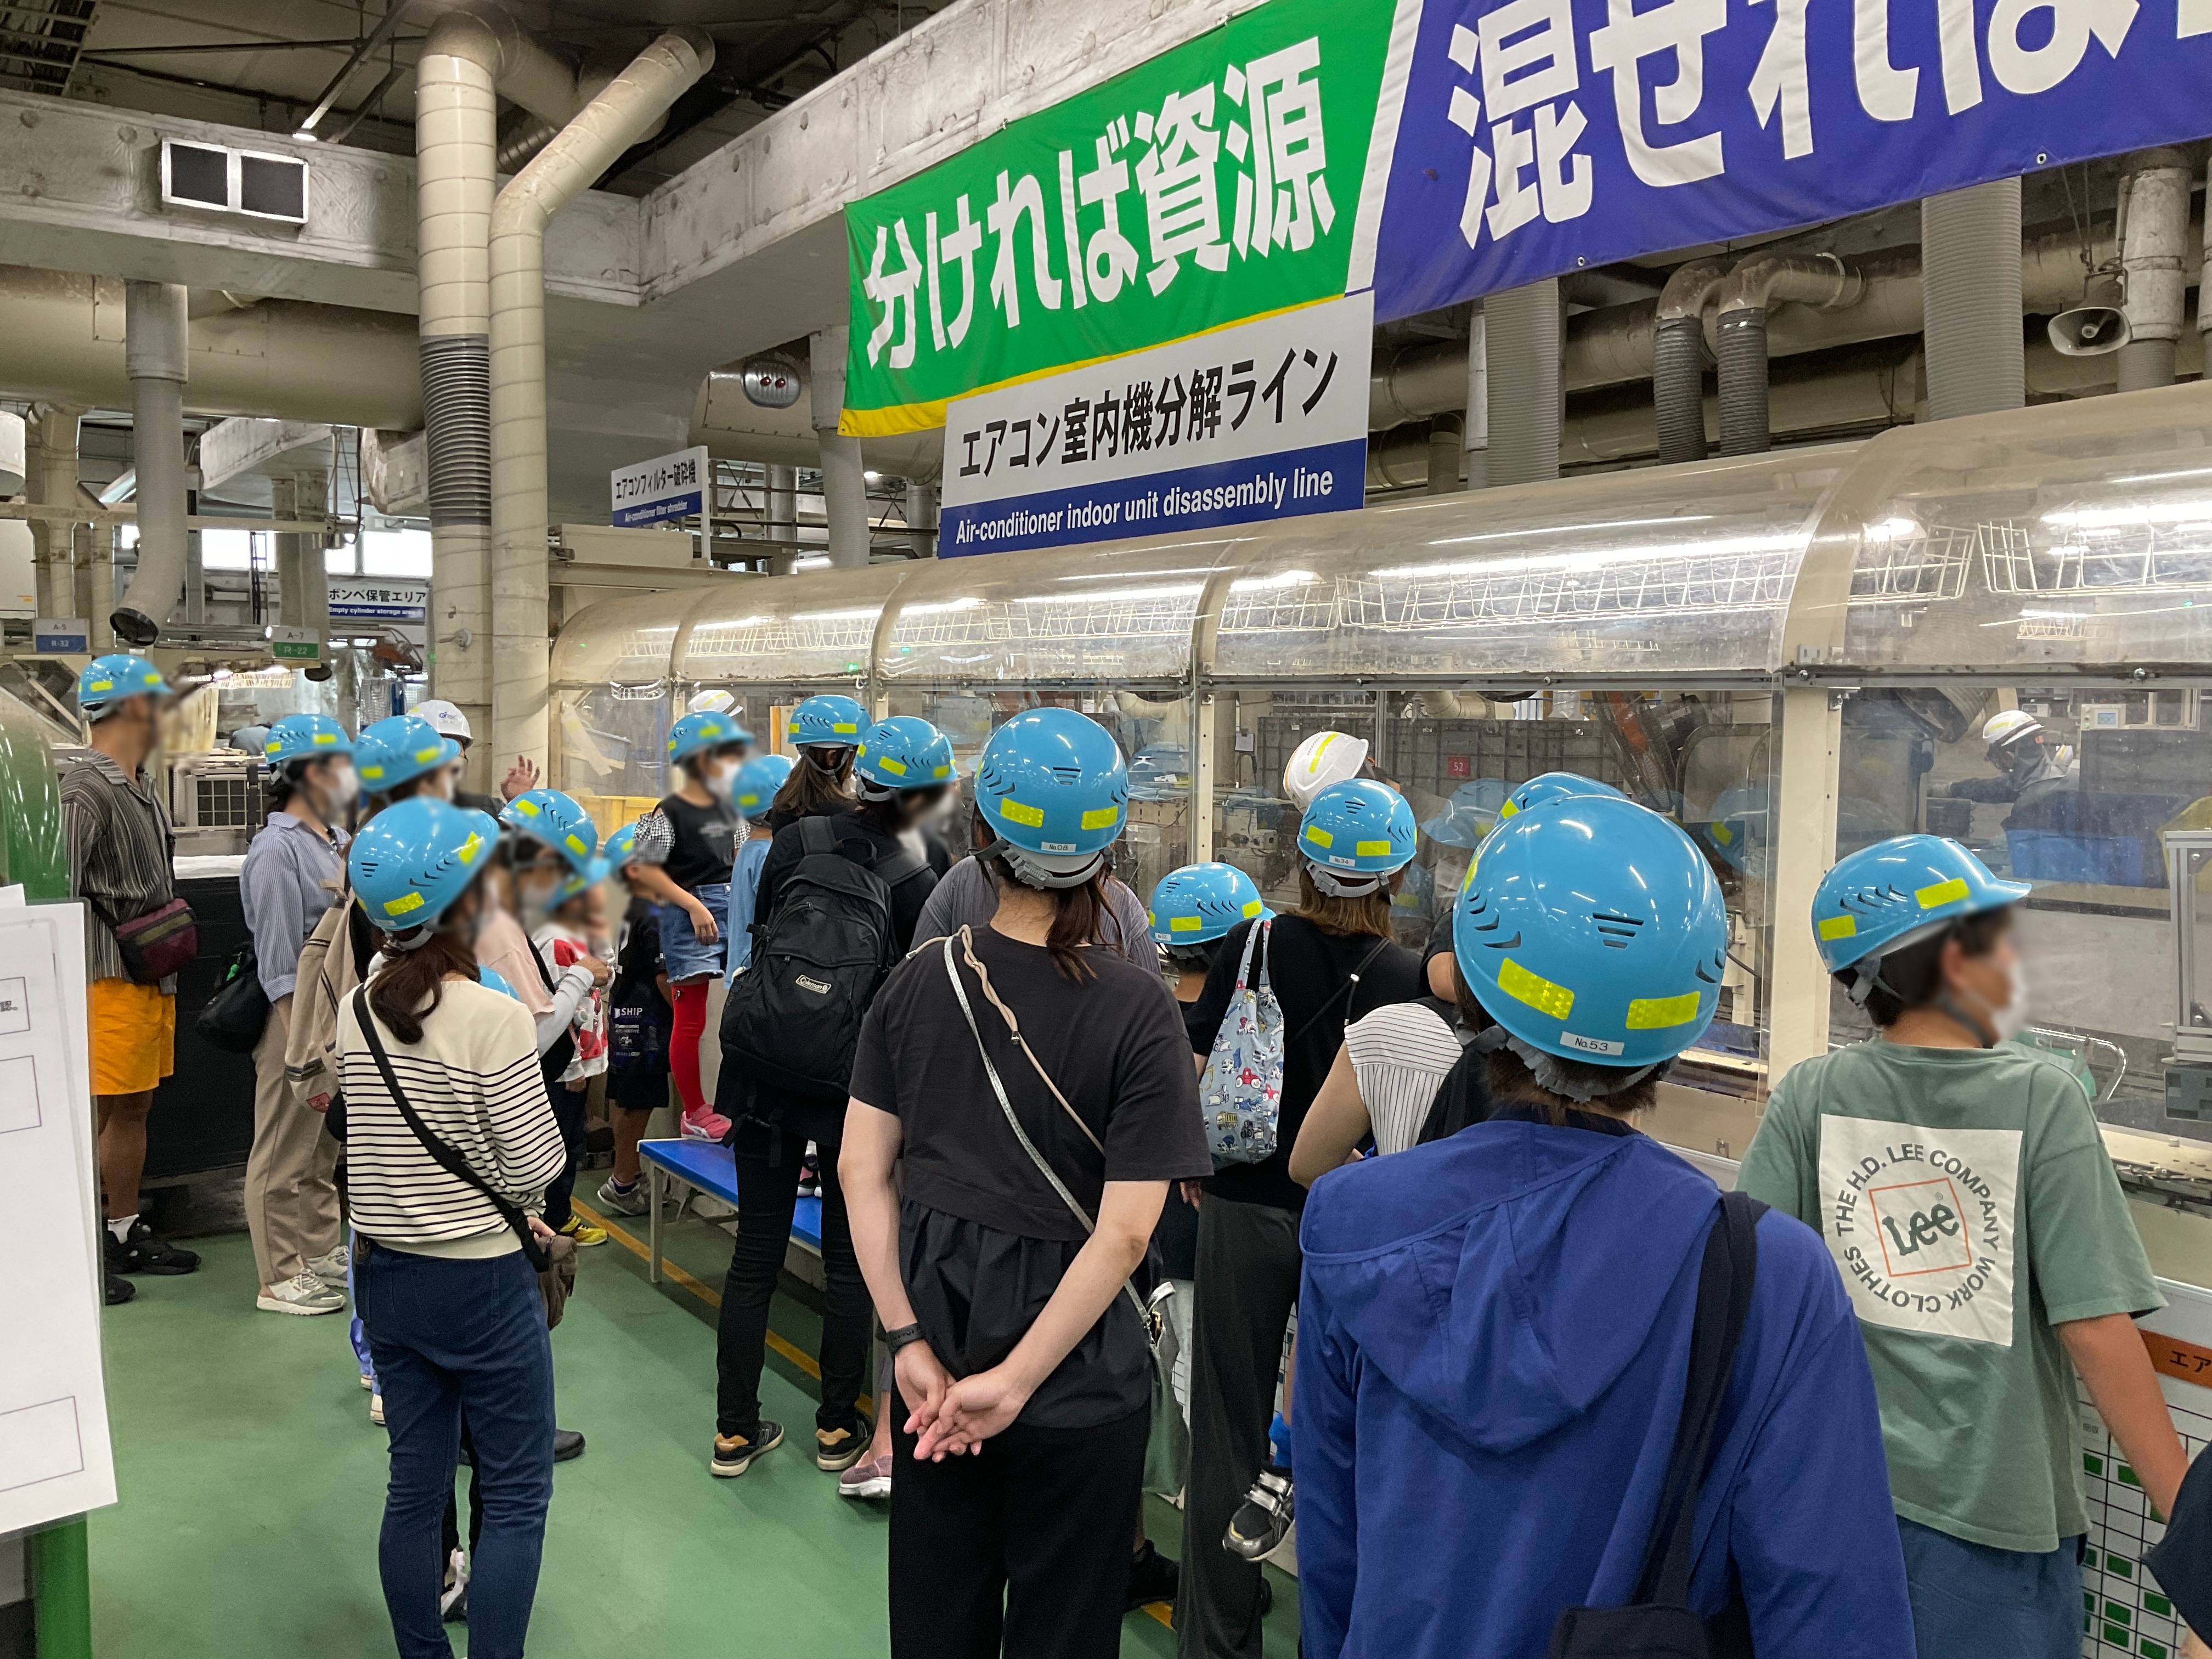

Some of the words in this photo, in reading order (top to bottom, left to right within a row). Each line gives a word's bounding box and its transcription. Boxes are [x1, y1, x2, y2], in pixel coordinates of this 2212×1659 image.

[863, 36, 1335, 369] 分ければ資源
[960, 347, 1339, 477] エアコン室内機分解ライン
[616, 459, 696, 499] エアコンフィルター破砕機
[625, 509, 656, 522] Air-conditioner
[656, 505, 667, 516] filter
[667, 500, 687, 513] shredder
[956, 507, 1063, 544] Air-conditioner
[1067, 501, 1121, 528] indoor
[1124, 492, 1159, 521] unit
[1163, 474, 1287, 517] disassembly
[1292, 466, 1333, 499] line
[329, 588, 426, 603] ボンベ保管エリア
[284, 646, 308, 654] R-22
[1454, 762, 1464, 771] 52
[799, 977, 822, 990] Coleman
[621, 1007, 643, 1016] SHIP
[1886, 1143, 1924, 1164] LEE
[1836, 1190, 1858, 1237] THE
[1929, 1150, 1998, 1251] COMPANY
[1882, 1204, 1960, 1256] Lee
[1844, 1246, 1942, 1313] CLOTHES
[1945, 1256, 1995, 1310] WORK
[2169, 1350, 2212, 1373] エア
